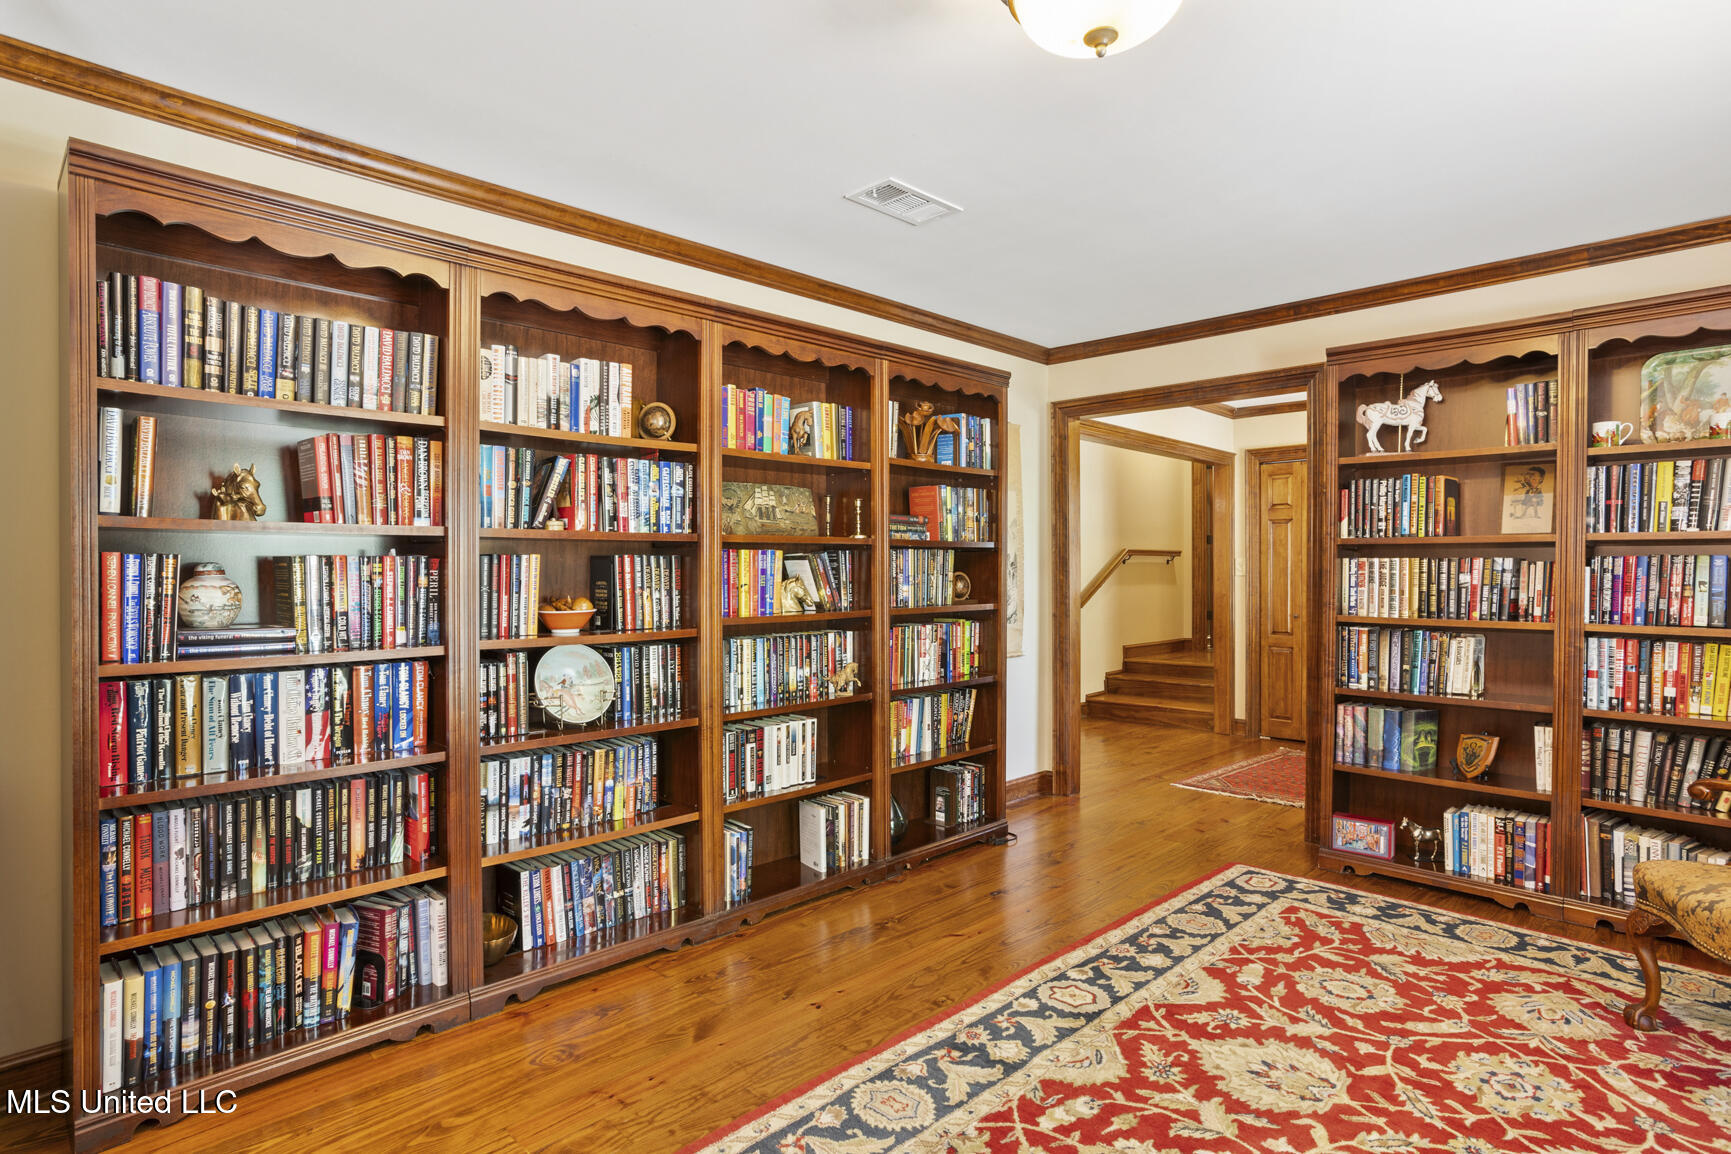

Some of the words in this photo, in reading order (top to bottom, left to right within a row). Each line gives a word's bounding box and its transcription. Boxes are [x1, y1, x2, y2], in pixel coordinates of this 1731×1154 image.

[352, 327, 361, 344] DAVID
[382, 331, 393, 355] DAVID
[352, 346, 360, 373] BALDACCI
[381, 356, 391, 393] BALDACCI
[622, 368, 632, 408] AIRFRAME
[106, 410, 119, 434] DAVID
[105, 435, 116, 474] BALDACCI
[418, 441, 428, 458] DAN
[418, 461, 427, 488] BROWN
[430, 570, 439, 598] PERIL
[1379, 571, 1387, 587] JUDGE
[361, 670, 372, 688] Tom
[379, 670, 389, 685] Tom
[230, 692, 241, 715] Without
[244, 700, 253, 712] Tom
[358, 690, 372, 715] Clancy
[376, 686, 389, 708] Clancy
[398, 682, 409, 708] CLANCY
[231, 717, 241, 743] Remorse
[241, 713, 253, 732] Clancy
[264, 714, 274, 730] Debt
[136, 728, 147, 755] Patriot
[264, 738, 274, 759] Honor
[1633, 744, 1648, 789] TUROW
[1654, 745, 1663, 766] TUROW
[136, 756, 147, 780] Games
[122, 821, 130, 844] MICHAEL
[122, 845, 131, 870] CONNELLY
[140, 834, 151, 860] TRUNK
[140, 867, 151, 893] MUSIC
[295, 946, 303, 977] BLACK
